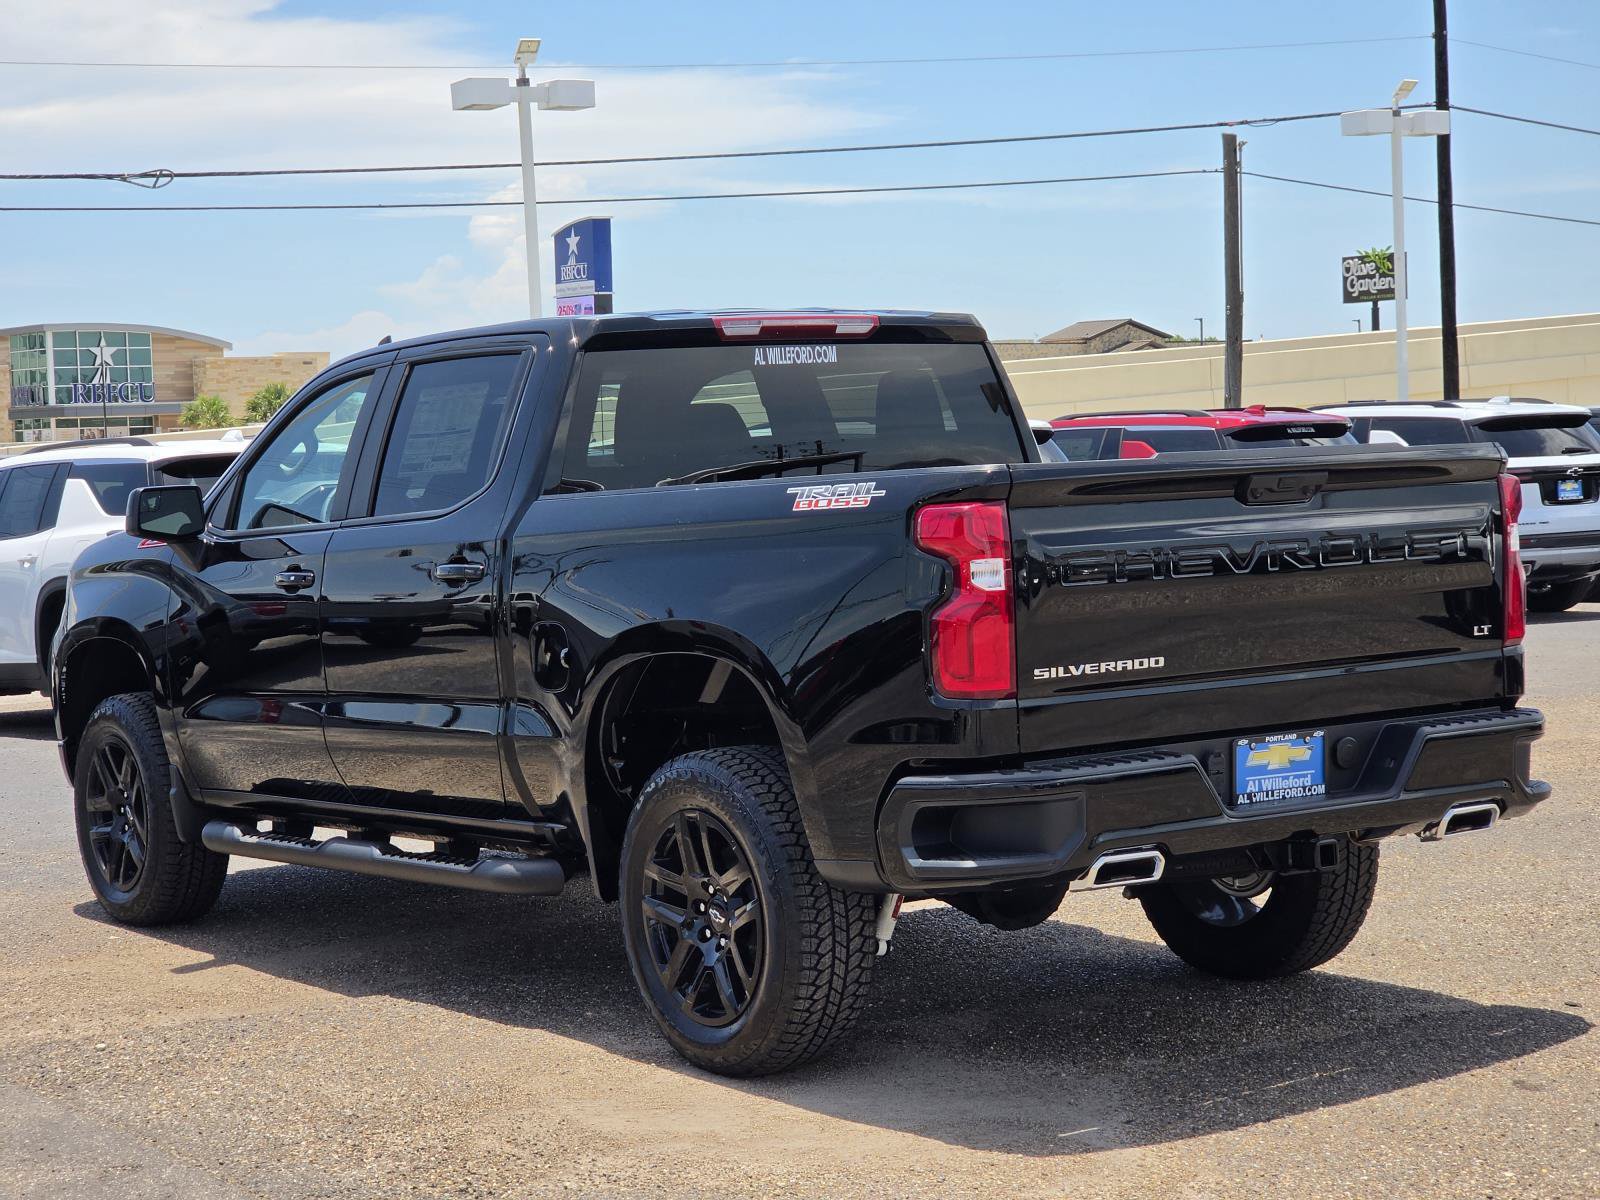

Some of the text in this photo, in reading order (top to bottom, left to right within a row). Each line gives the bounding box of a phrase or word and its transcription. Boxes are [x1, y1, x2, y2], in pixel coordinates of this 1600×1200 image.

[561, 264, 588, 280] RBFCU
[1343, 259, 1377, 277] Olive
[1347, 274, 1396, 297] Garden
[754, 346, 837, 365] AL WILLEFORD.COM
[71, 382, 155, 404] RBFCU
[787, 482, 886, 500] TRAIL
[792, 497, 871, 511] BOSS
[1060, 529, 1481, 586] CHEVROLET
[1473, 624, 1492, 636] LT
[1033, 656, 1165, 680] SILVERADO
[1265, 734, 1297, 743] PORTLAND
[1246, 775, 1312, 793] Al Willeford
[1237, 784, 1326, 805] AL WILLEFORD.COM
